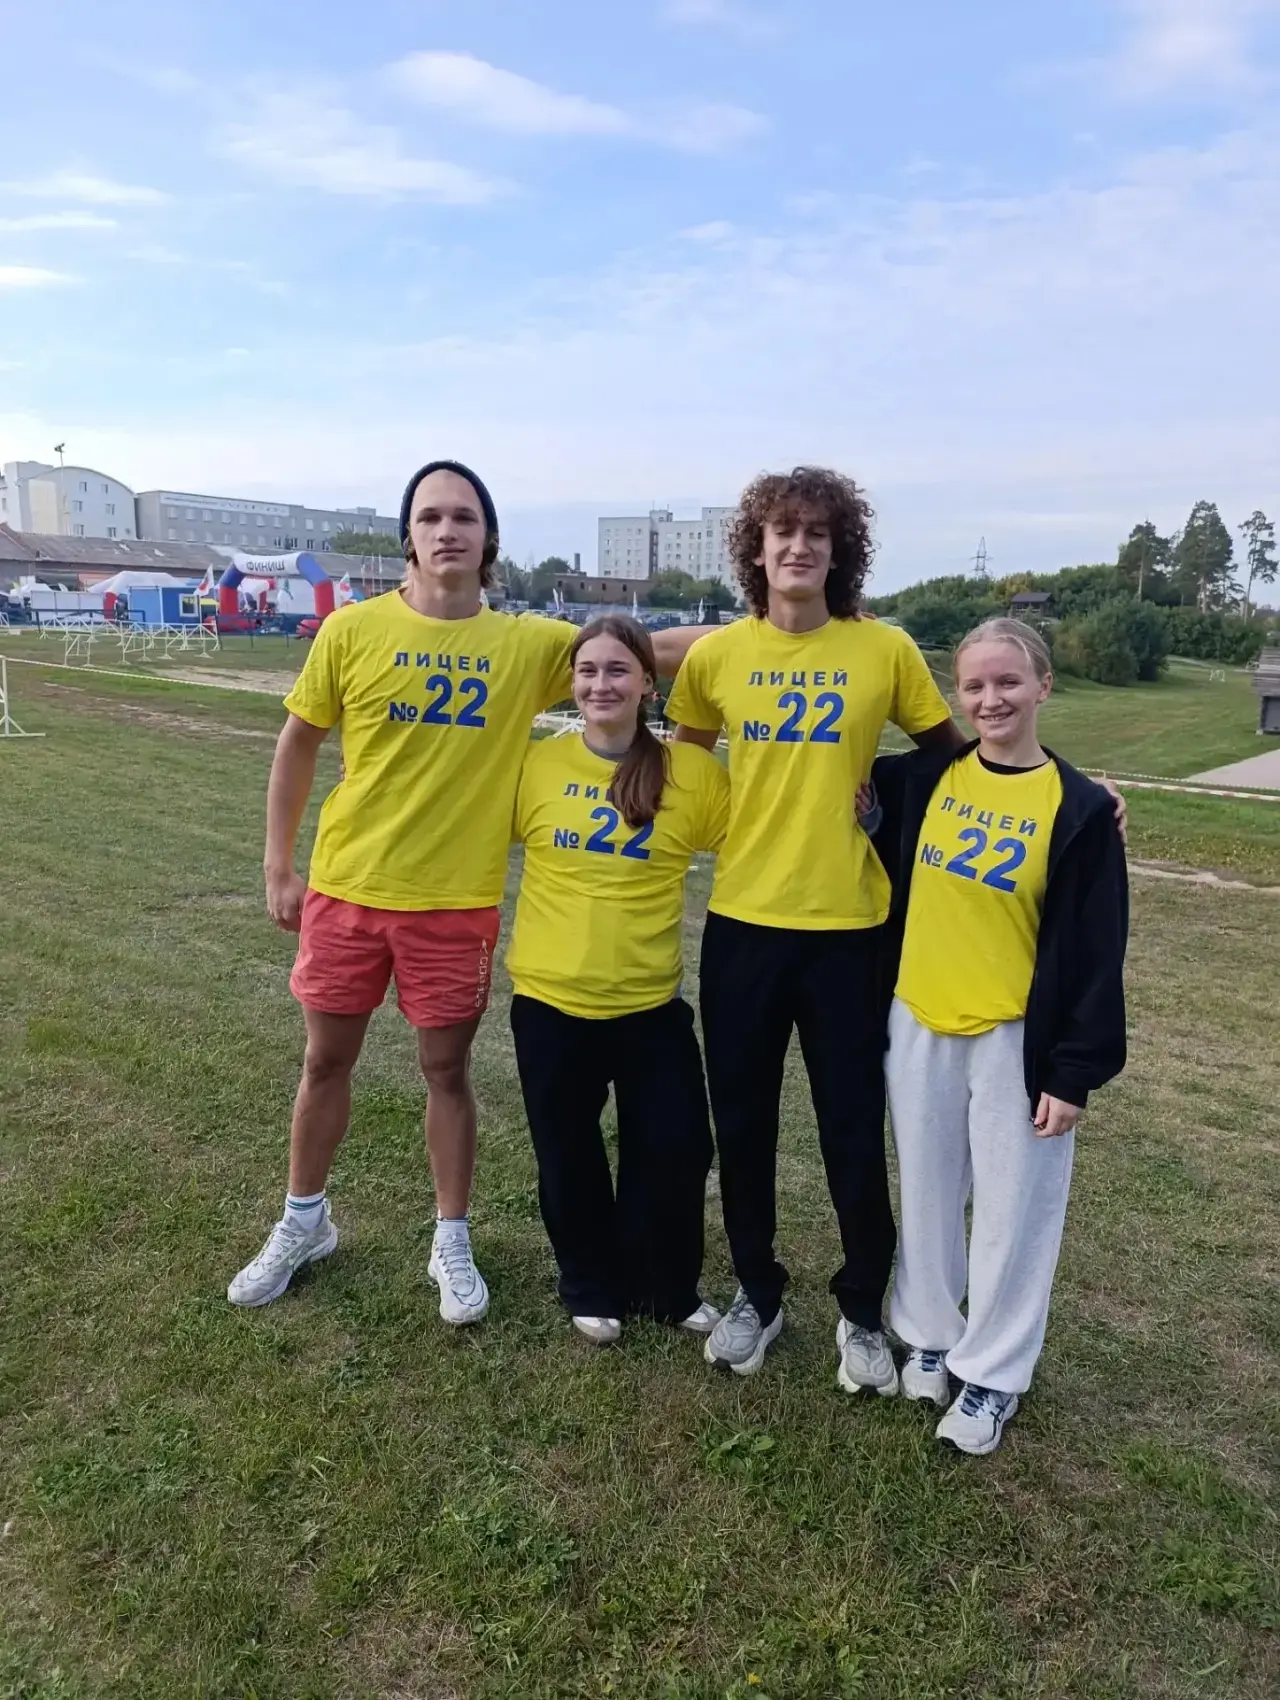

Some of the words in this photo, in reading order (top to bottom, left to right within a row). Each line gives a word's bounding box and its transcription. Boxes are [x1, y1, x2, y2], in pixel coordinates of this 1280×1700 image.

[246, 560, 285, 572] ФИНИШ
[394, 652, 490, 673] ЛИЦЕЙ
[748, 668, 849, 687] ЛИЦЕЙ
[940, 796, 1038, 837] ЛИЦЕЙ
